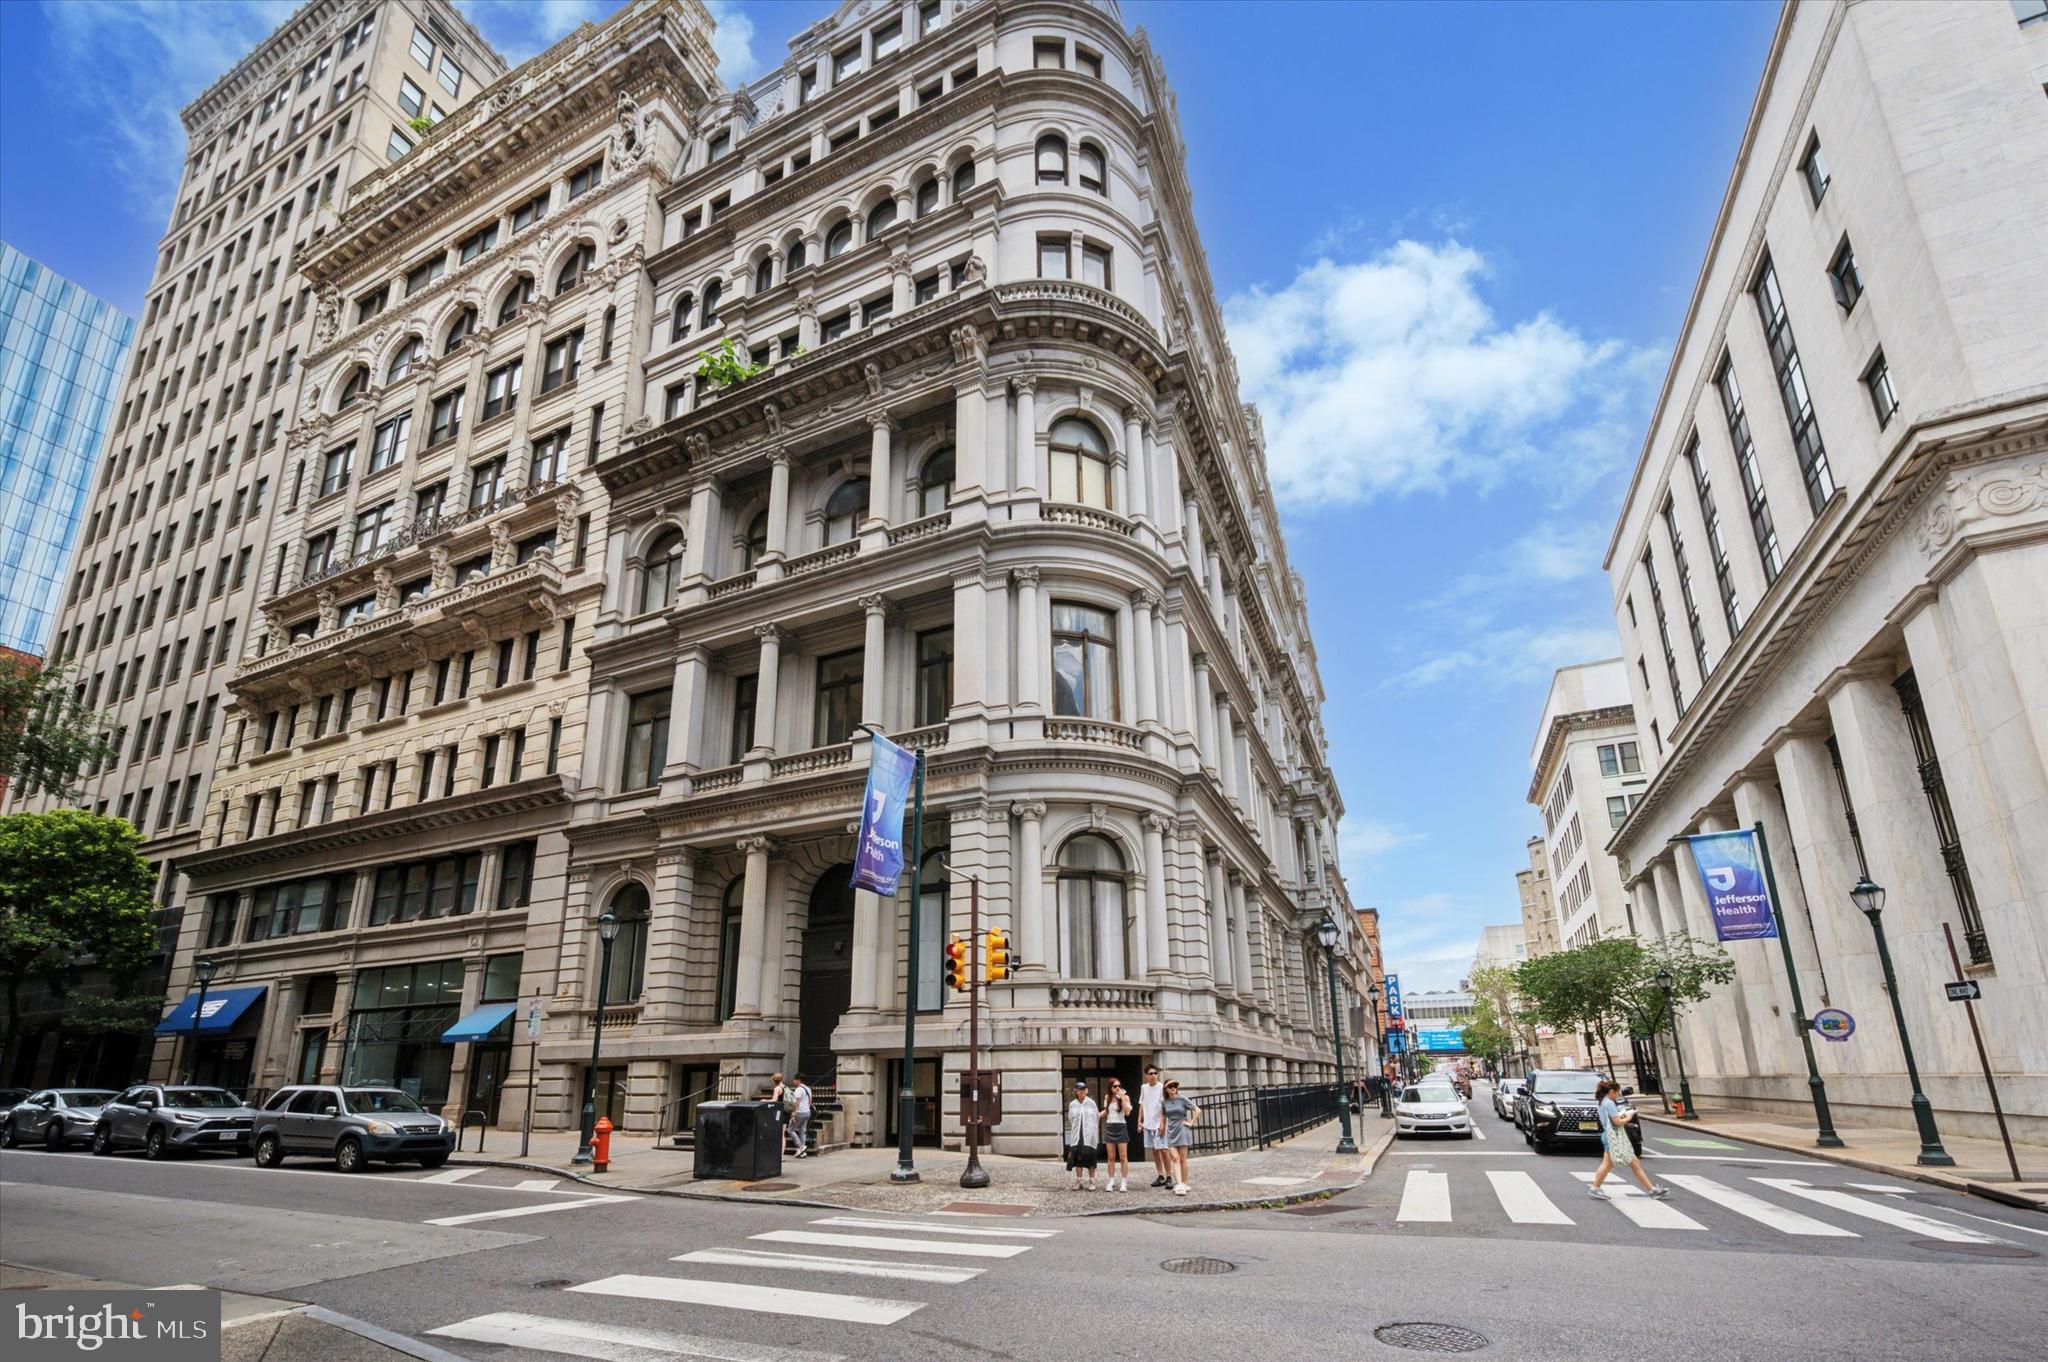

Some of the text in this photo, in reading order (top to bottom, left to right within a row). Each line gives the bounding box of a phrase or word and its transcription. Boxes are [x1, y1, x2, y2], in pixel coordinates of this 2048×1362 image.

[867, 827, 899, 849] Jferson
[865, 842, 884, 862] Hlth
[1714, 894, 1766, 905] Jefferson
[1716, 905, 1756, 916] Health
[1387, 976, 1400, 1015] PARK
